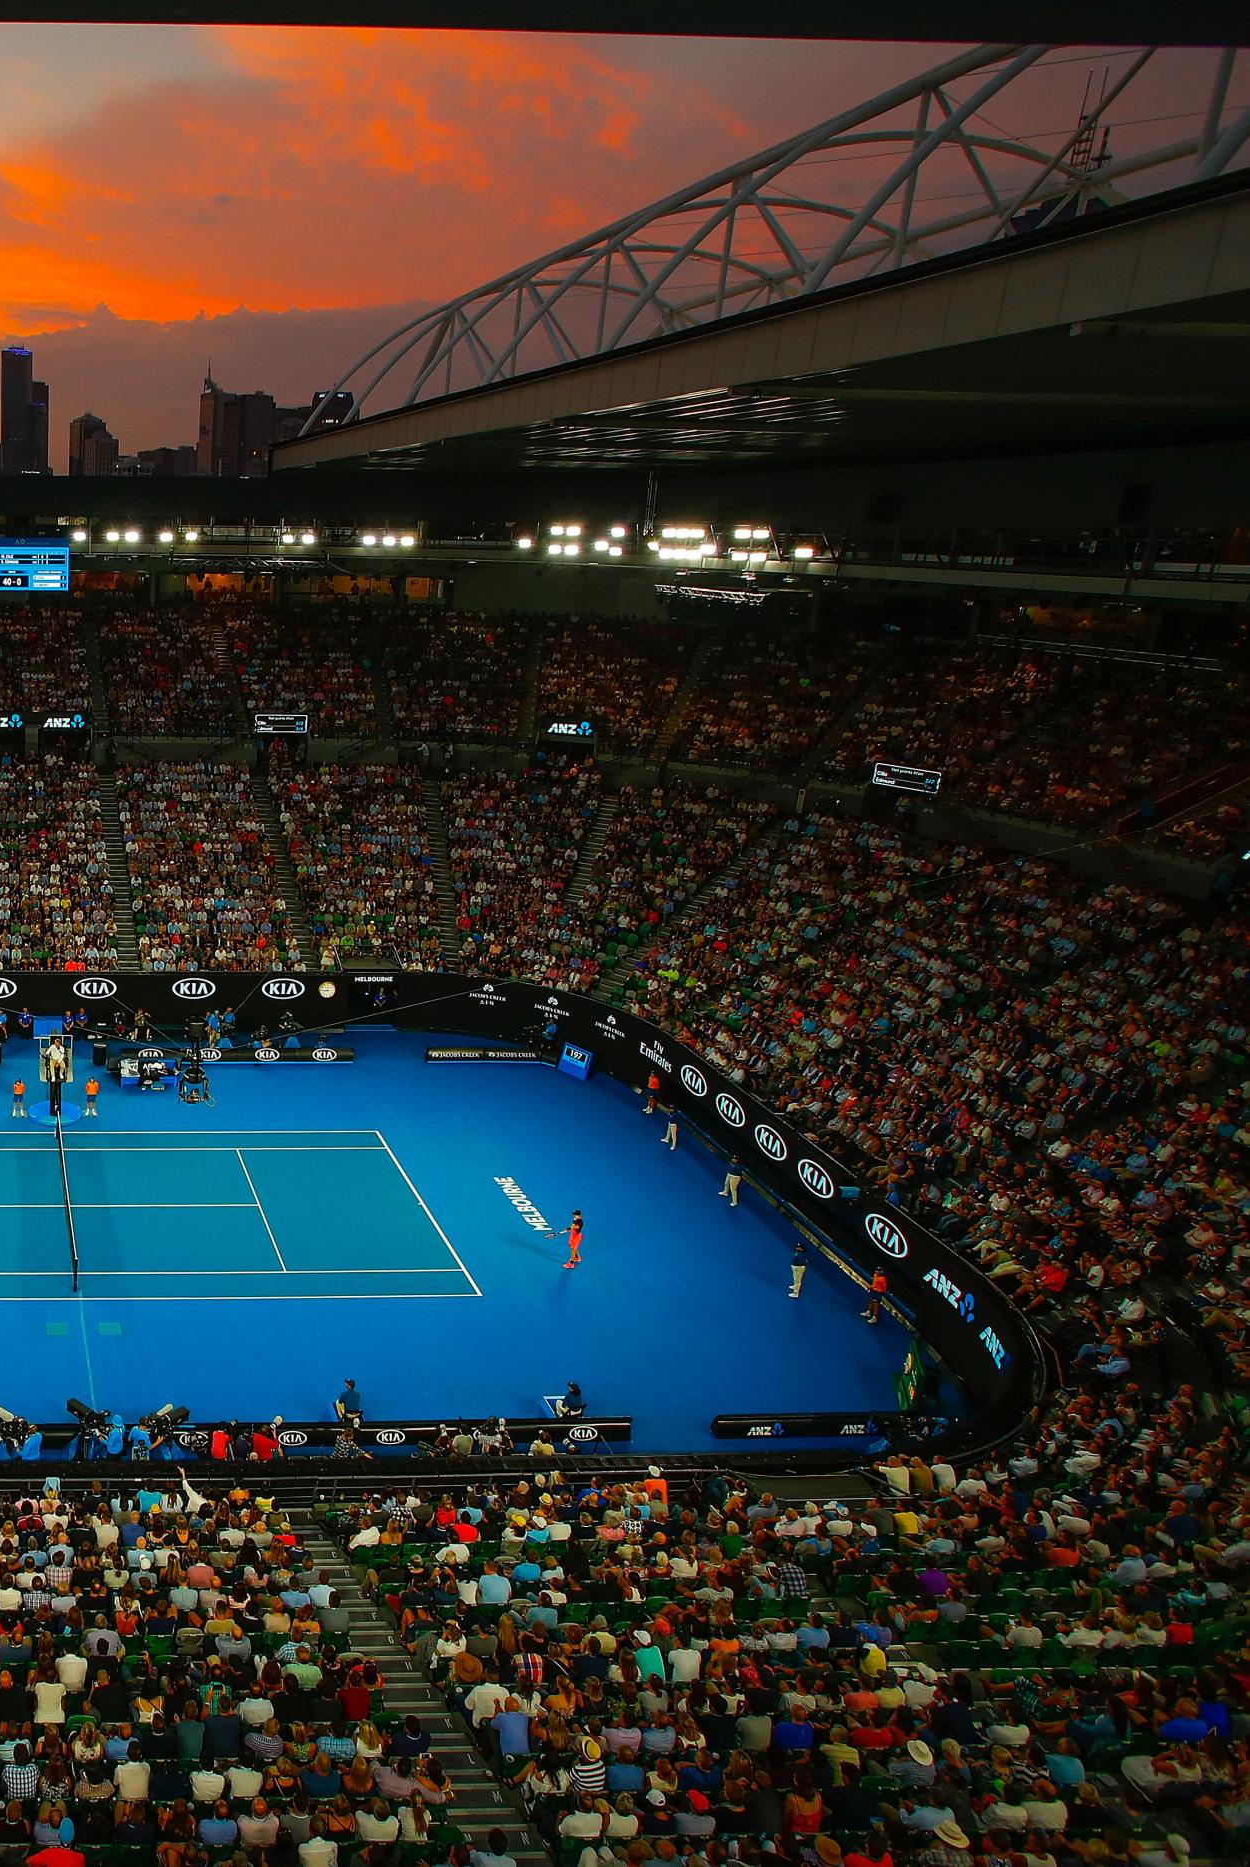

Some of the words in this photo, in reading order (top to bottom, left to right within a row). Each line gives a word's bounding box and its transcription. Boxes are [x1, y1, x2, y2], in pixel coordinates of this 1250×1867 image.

[2, 578, 12, 586] 40
[43, 718, 71, 728] ANZ
[547, 722, 578, 734] ANZ
[80, 982, 109, 994] KIA
[179, 982, 208, 994] KIA
[270, 982, 297, 995] KIA
[490, 994, 506, 1002] CREEK
[612, 1028, 625, 1037] CREEK
[653, 1040, 664, 1055] Fly
[200, 1050, 218, 1058] KIA
[259, 1050, 276, 1059] KIA
[317, 1050, 334, 1059] KIA
[570, 1049, 583, 1060] 197
[640, 1041, 673, 1074] Emirates
[684, 1067, 702, 1094] KIA
[720, 1096, 740, 1125] KIA
[758, 1126, 781, 1158] KIA
[802, 1162, 827, 1196] KIA
[493, 1176, 552, 1231] MELBOURNE
[870, 1217, 900, 1254] KIA
[922, 1268, 962, 1310] ANZ
[978, 1326, 1005, 1370] ANZ
[574, 1430, 593, 1438] KIA
[747, 1426, 772, 1436] ANZ
[840, 1424, 865, 1434] ANZ
[282, 1434, 302, 1443] KIA
[380, 1433, 400, 1442] KIA
